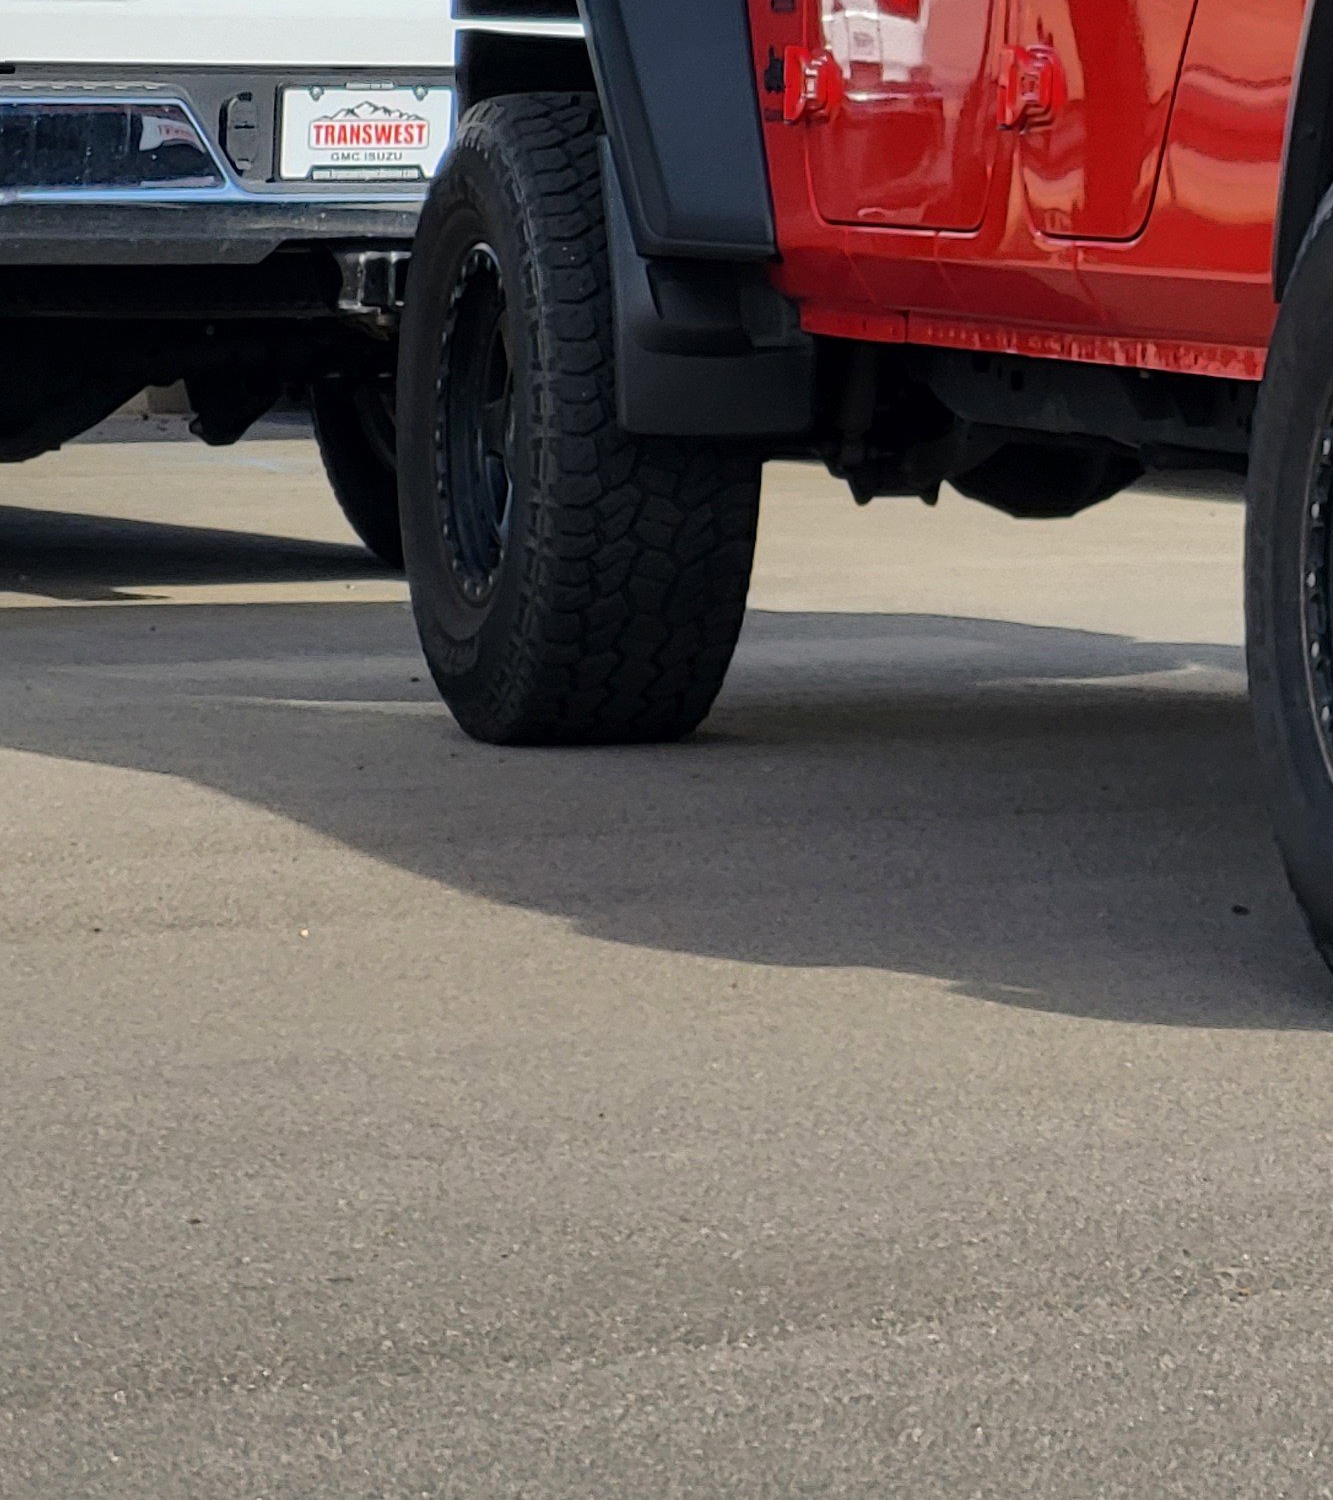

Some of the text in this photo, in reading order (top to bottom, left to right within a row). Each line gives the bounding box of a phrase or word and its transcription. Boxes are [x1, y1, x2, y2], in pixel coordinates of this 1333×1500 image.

[313, 123, 427, 145] TRANSWEST
[331, 152, 403, 161] GMC ISUZU
